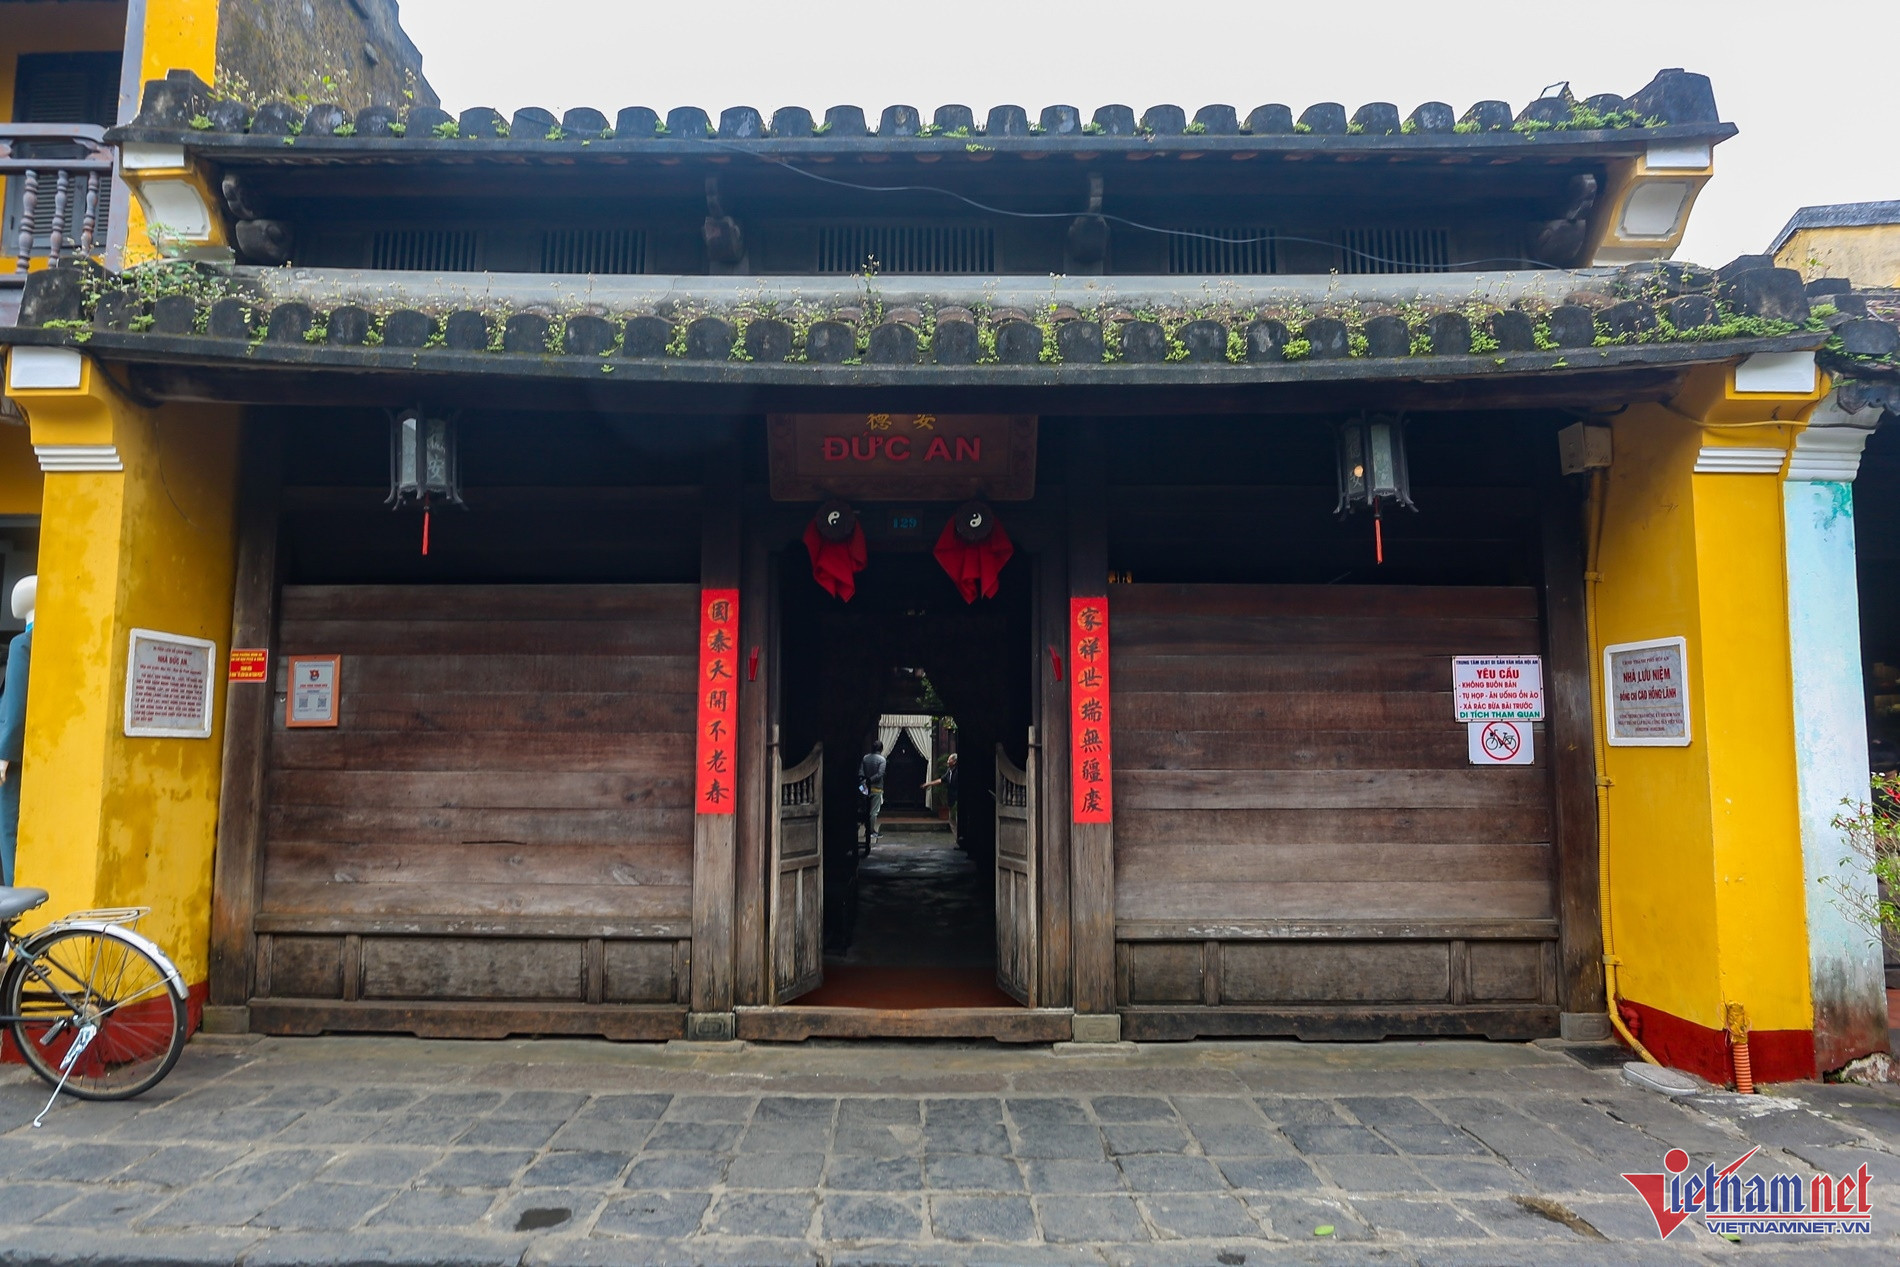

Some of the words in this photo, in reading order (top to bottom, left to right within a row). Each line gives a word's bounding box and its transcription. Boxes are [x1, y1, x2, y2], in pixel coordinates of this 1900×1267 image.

[822, 431, 911, 461] ĐỨC
[923, 436, 981, 461] AN
[893, 518, 917, 528] 129
[1477, 668, 1496, 679] YÊU
[1623, 669, 1636, 683] NHÀ
[1638, 668, 1651, 682] LƯU
[1653, 666, 1670, 682] NIỆM
[1500, 690, 1517, 698] UỐNG
[1638, 690, 1647, 700] CAO
[705, 601, 732, 804] 國泰天開不老春
[1470, 710, 1489, 718] TÍCH
